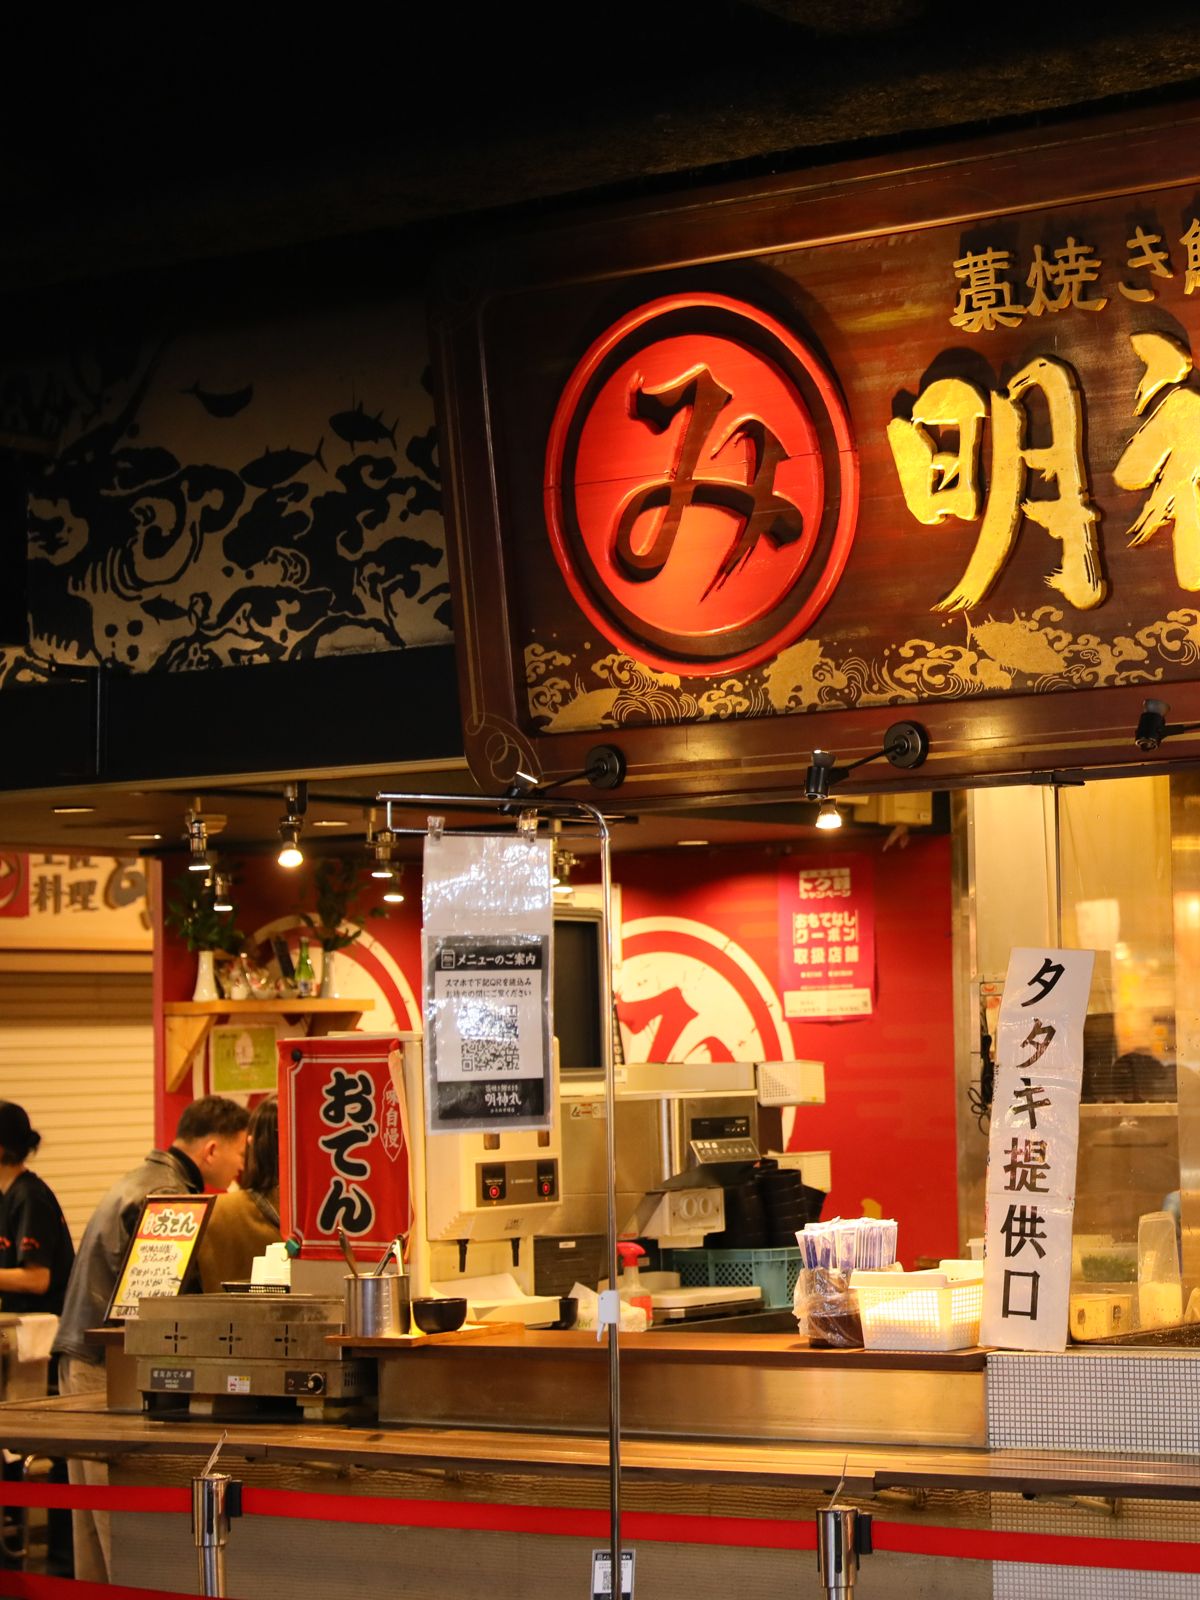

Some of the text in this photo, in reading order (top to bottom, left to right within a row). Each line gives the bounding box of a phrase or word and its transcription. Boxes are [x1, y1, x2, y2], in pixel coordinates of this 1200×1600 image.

[615, 366, 804, 602] み
[31, 873, 99, 914] 料理
[795, 911, 857, 929] おもてなし
[795, 927, 856, 945] クーポン
[457, 952, 536, 966] メニューのご案内
[793, 946, 859, 965] 取扱店舗
[484, 1091, 522, 1108] 明神丸
[382, 1089, 400, 1149] 味自慢
[1000, 958, 1066, 1321] タタキ提供口
[318, 1069, 377, 1235] おでん
[152, 1211, 196, 1234] おでん
